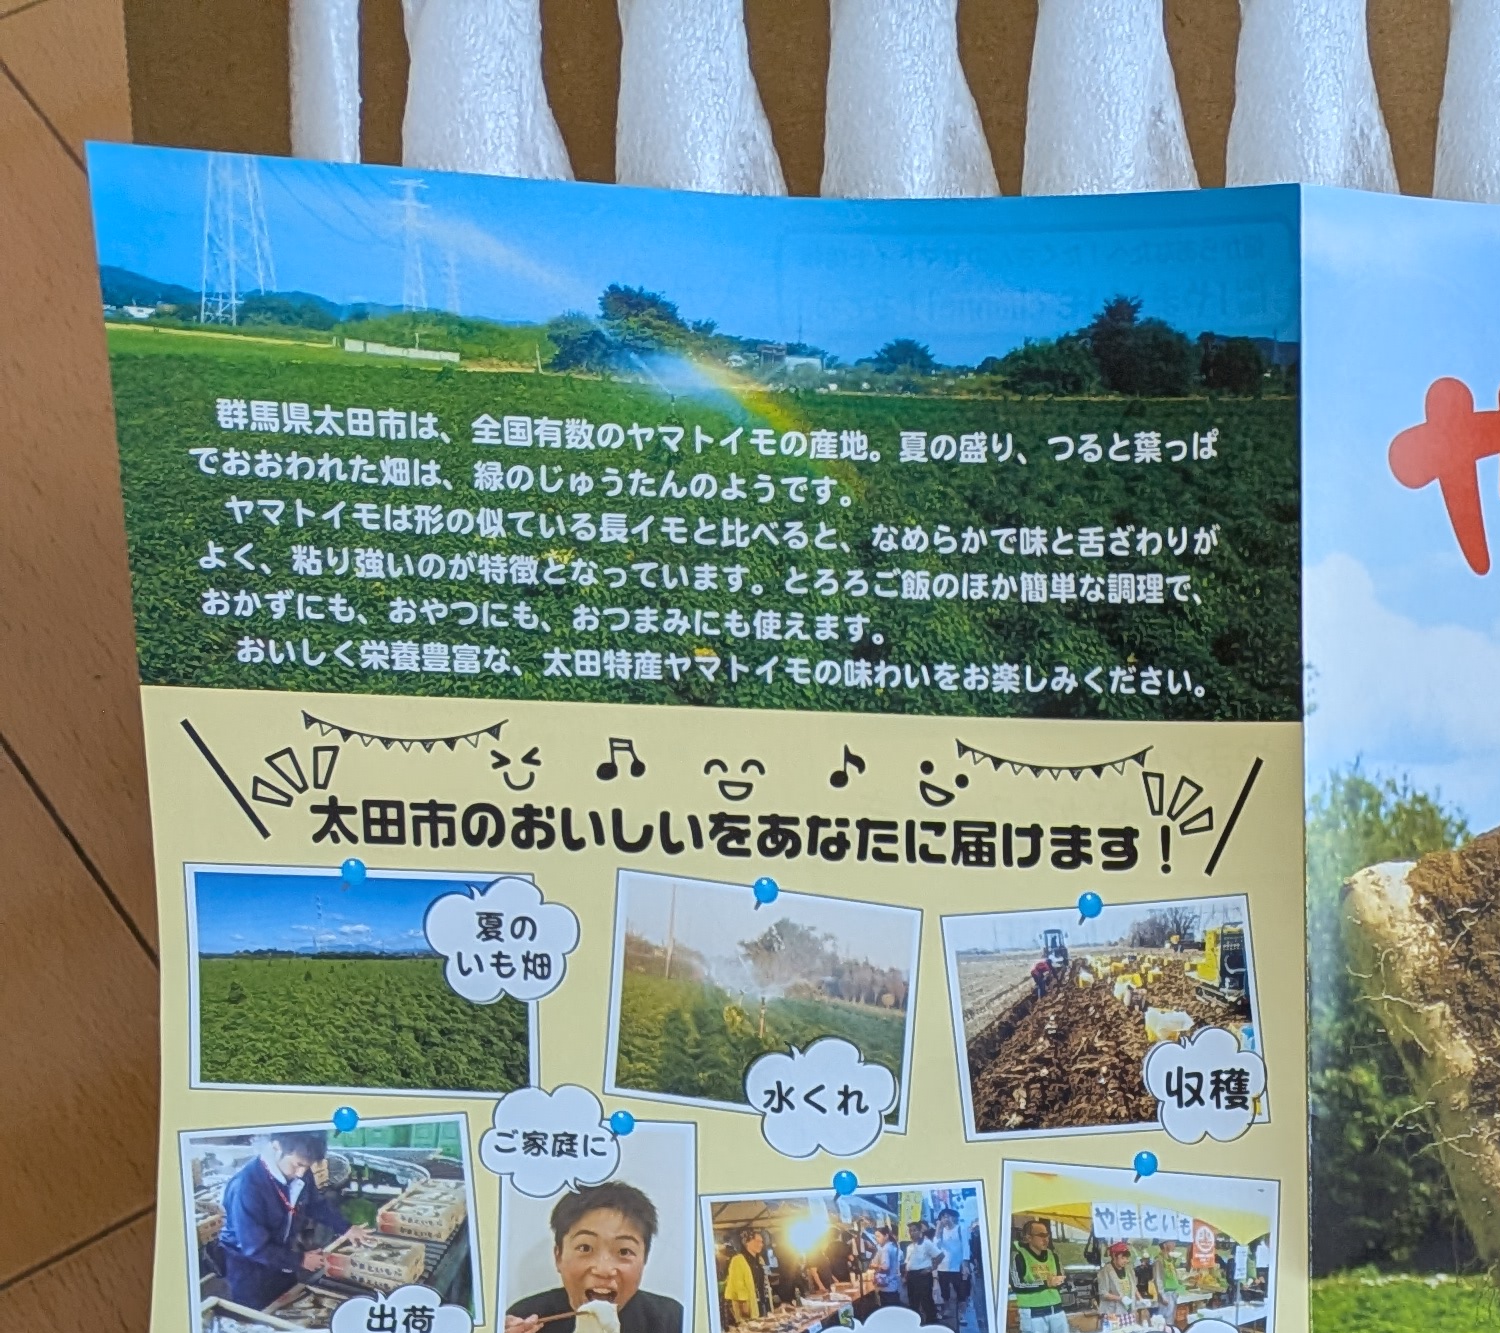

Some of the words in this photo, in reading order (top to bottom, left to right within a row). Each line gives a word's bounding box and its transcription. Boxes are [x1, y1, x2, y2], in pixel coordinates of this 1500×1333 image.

[215, 397, 1218, 464] 群馬県太田市は、全国有数のヤマトイモの産地。夏の盛り、つると葉っぱ
[189, 446, 852, 508] でおおわれた畑は、緑のじゅうたんのようです。
[225, 497, 1219, 557] ヤマトイモは形の似ている長イモと比べると、なめらかで味と舌ざわりが
[202, 588, 885, 645] おかずにも、おやつにも、おつまみにも使えます。
[237, 635, 1206, 697] おいしく栄養豊富な、太田特産ヤマトイモの味わいをお楽しみください。
[310, 795, 1172, 874] 太田市のおいしいをあなたに届けます！
[475, 911, 537, 942] 夏の
[458, 952, 552, 981] いも畑
[762, 1081, 870, 1116] 水くれ
[1165, 1066, 1252, 1110] 収穫
[494, 1129, 608, 1159] ご家庭に
[1095, 1205, 1192, 1237] やまといも
